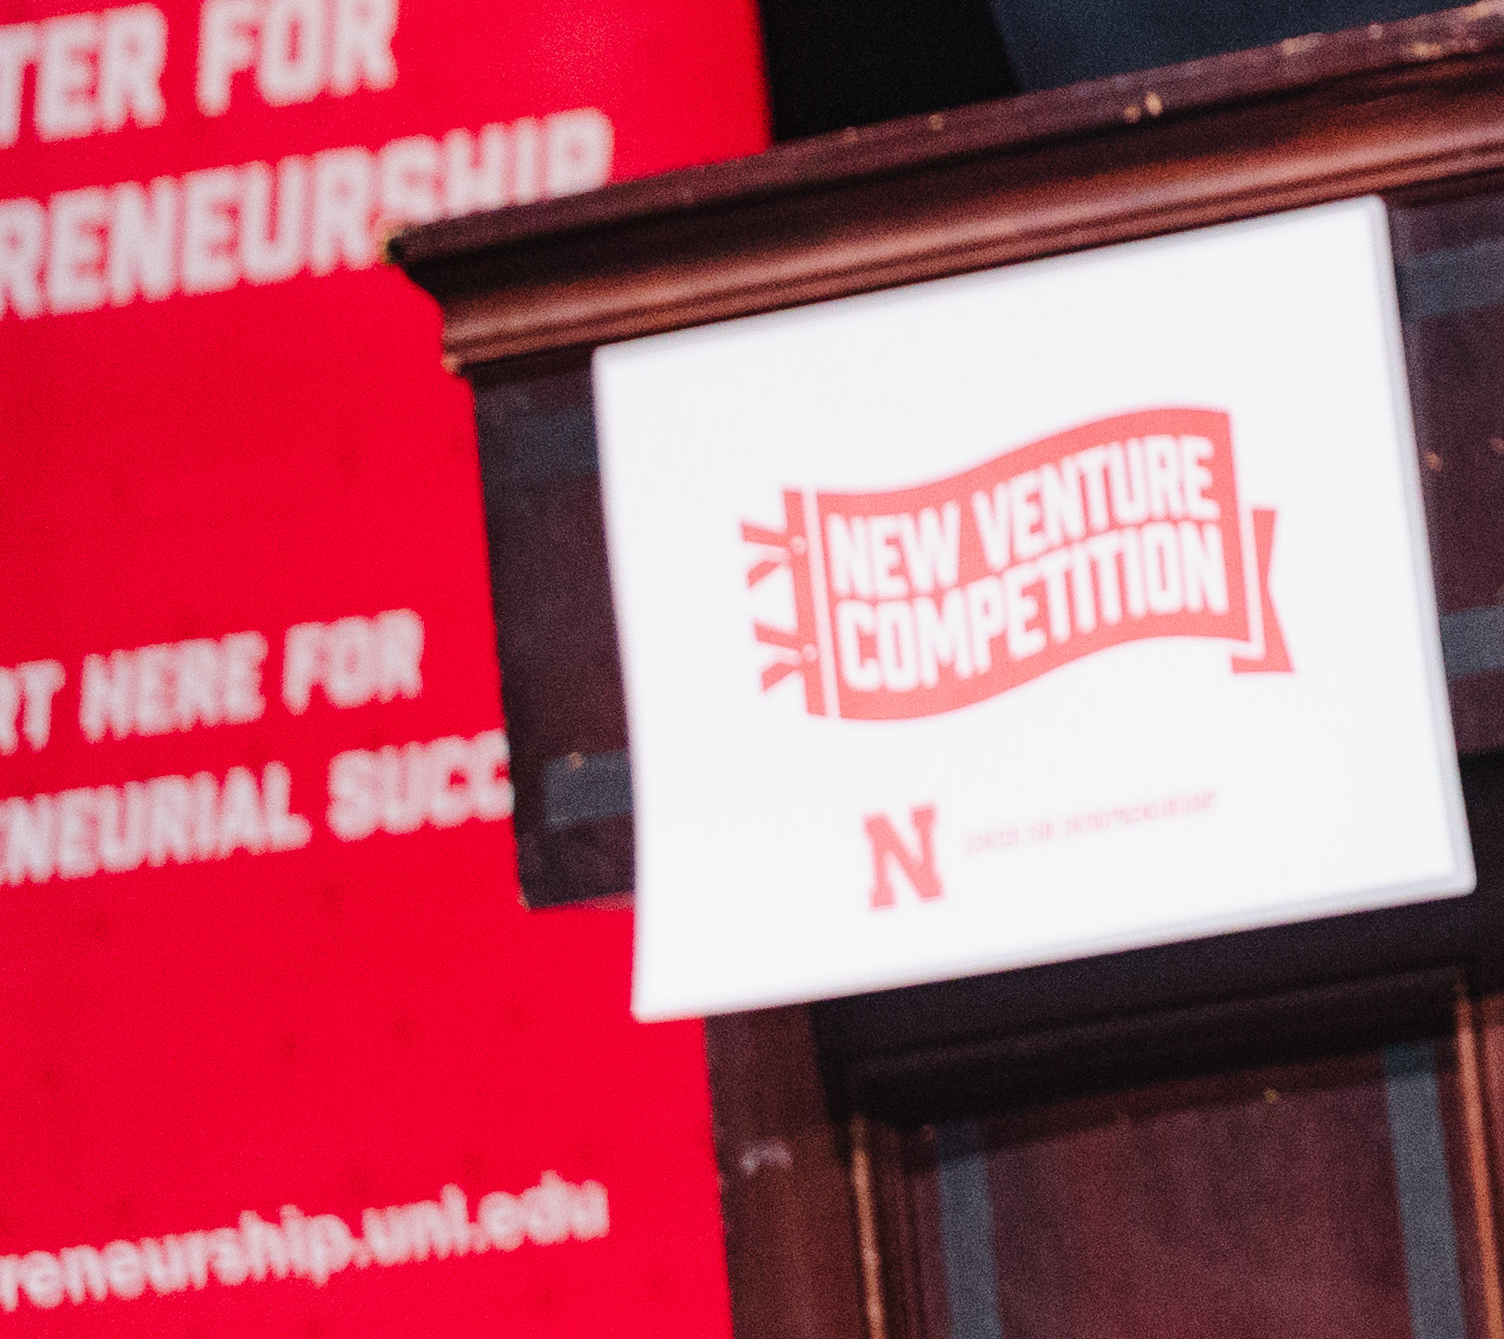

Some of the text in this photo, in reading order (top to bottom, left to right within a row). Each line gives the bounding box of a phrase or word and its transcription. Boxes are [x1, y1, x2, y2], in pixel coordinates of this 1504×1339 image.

[0, 3, 167, 149] TER
[825, 433, 1221, 599] NEW VENTURE
[79, 630, 269, 744] HERE
[282, 607, 425, 716] FOR
[835, 519, 1230, 693] COMPETITION
[0, 727, 514, 886] NEURIAL SUCC
[863, 802, 945, 911] N
